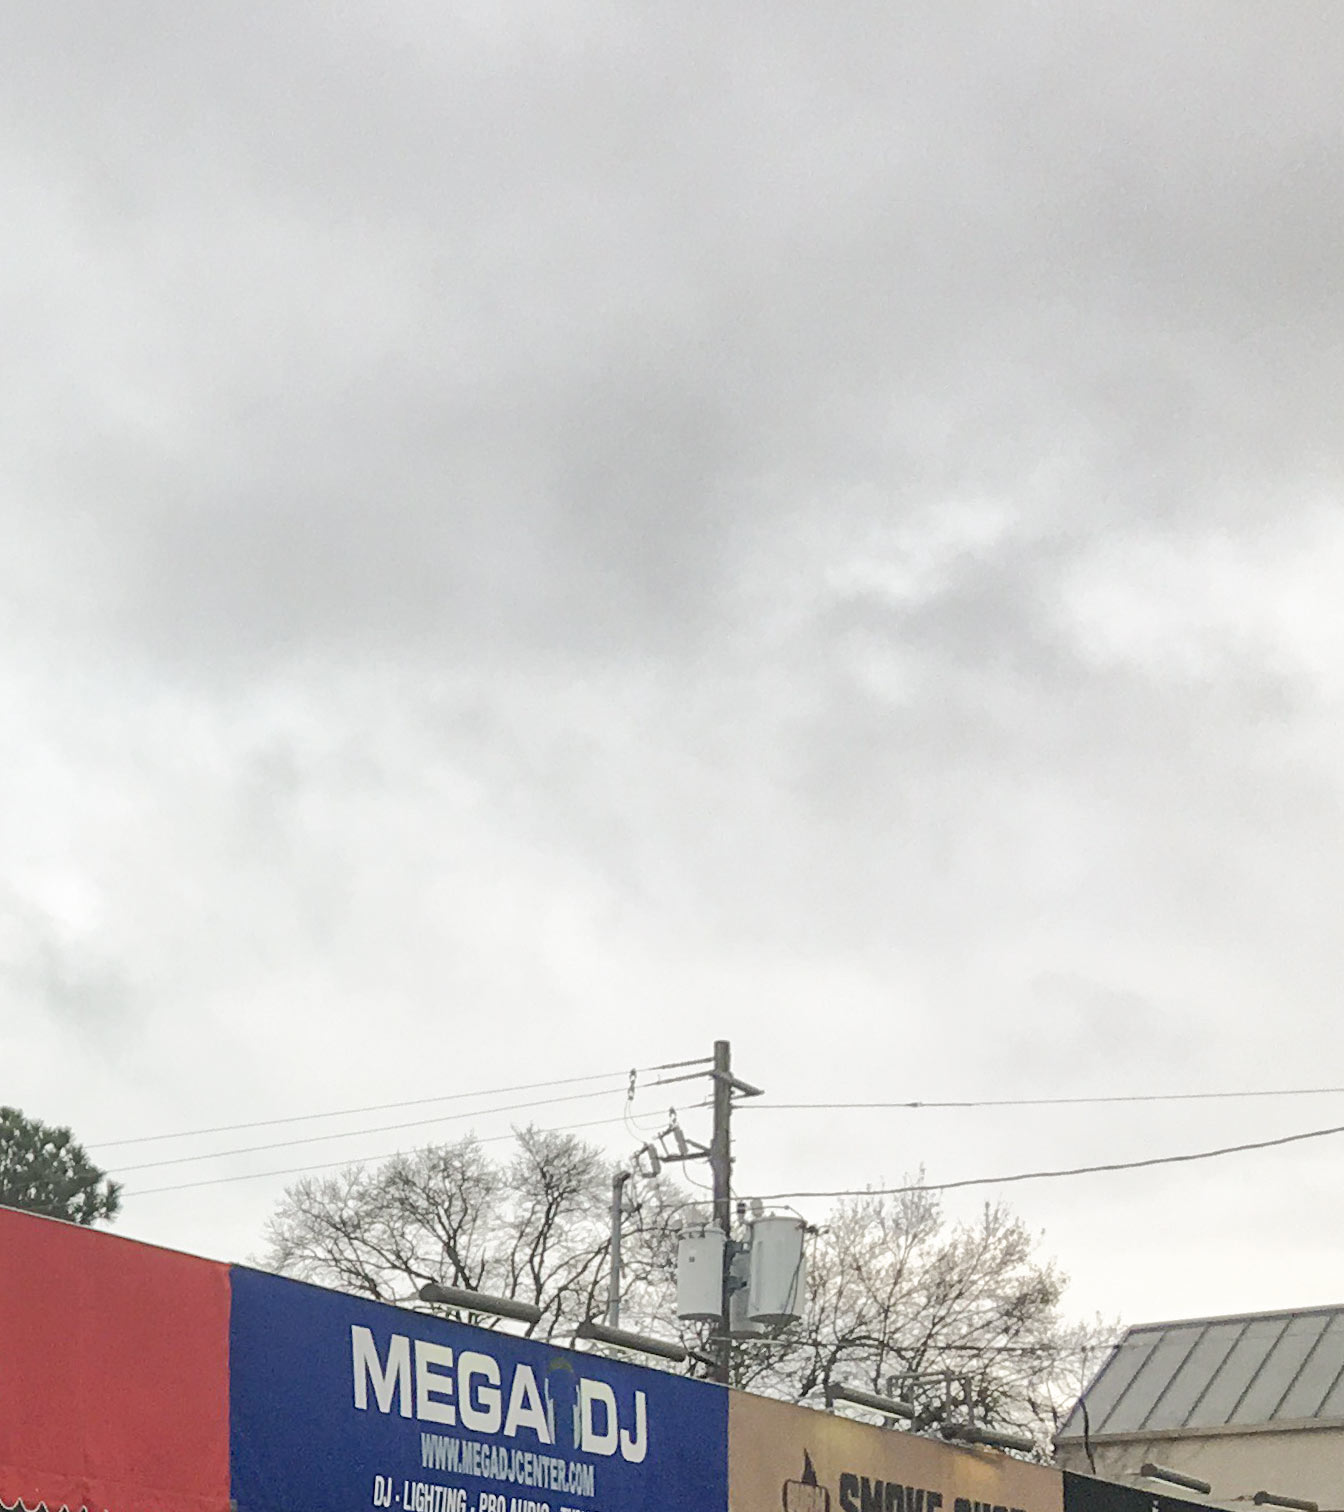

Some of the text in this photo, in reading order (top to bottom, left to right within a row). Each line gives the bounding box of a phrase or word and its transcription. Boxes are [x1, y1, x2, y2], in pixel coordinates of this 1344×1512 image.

[351, 1324, 647, 1463] MEGA DJ
[373, 1475, 393, 1508] DJ
[420, 1432, 595, 1497] WWW.MEGADJCENTER.COM
